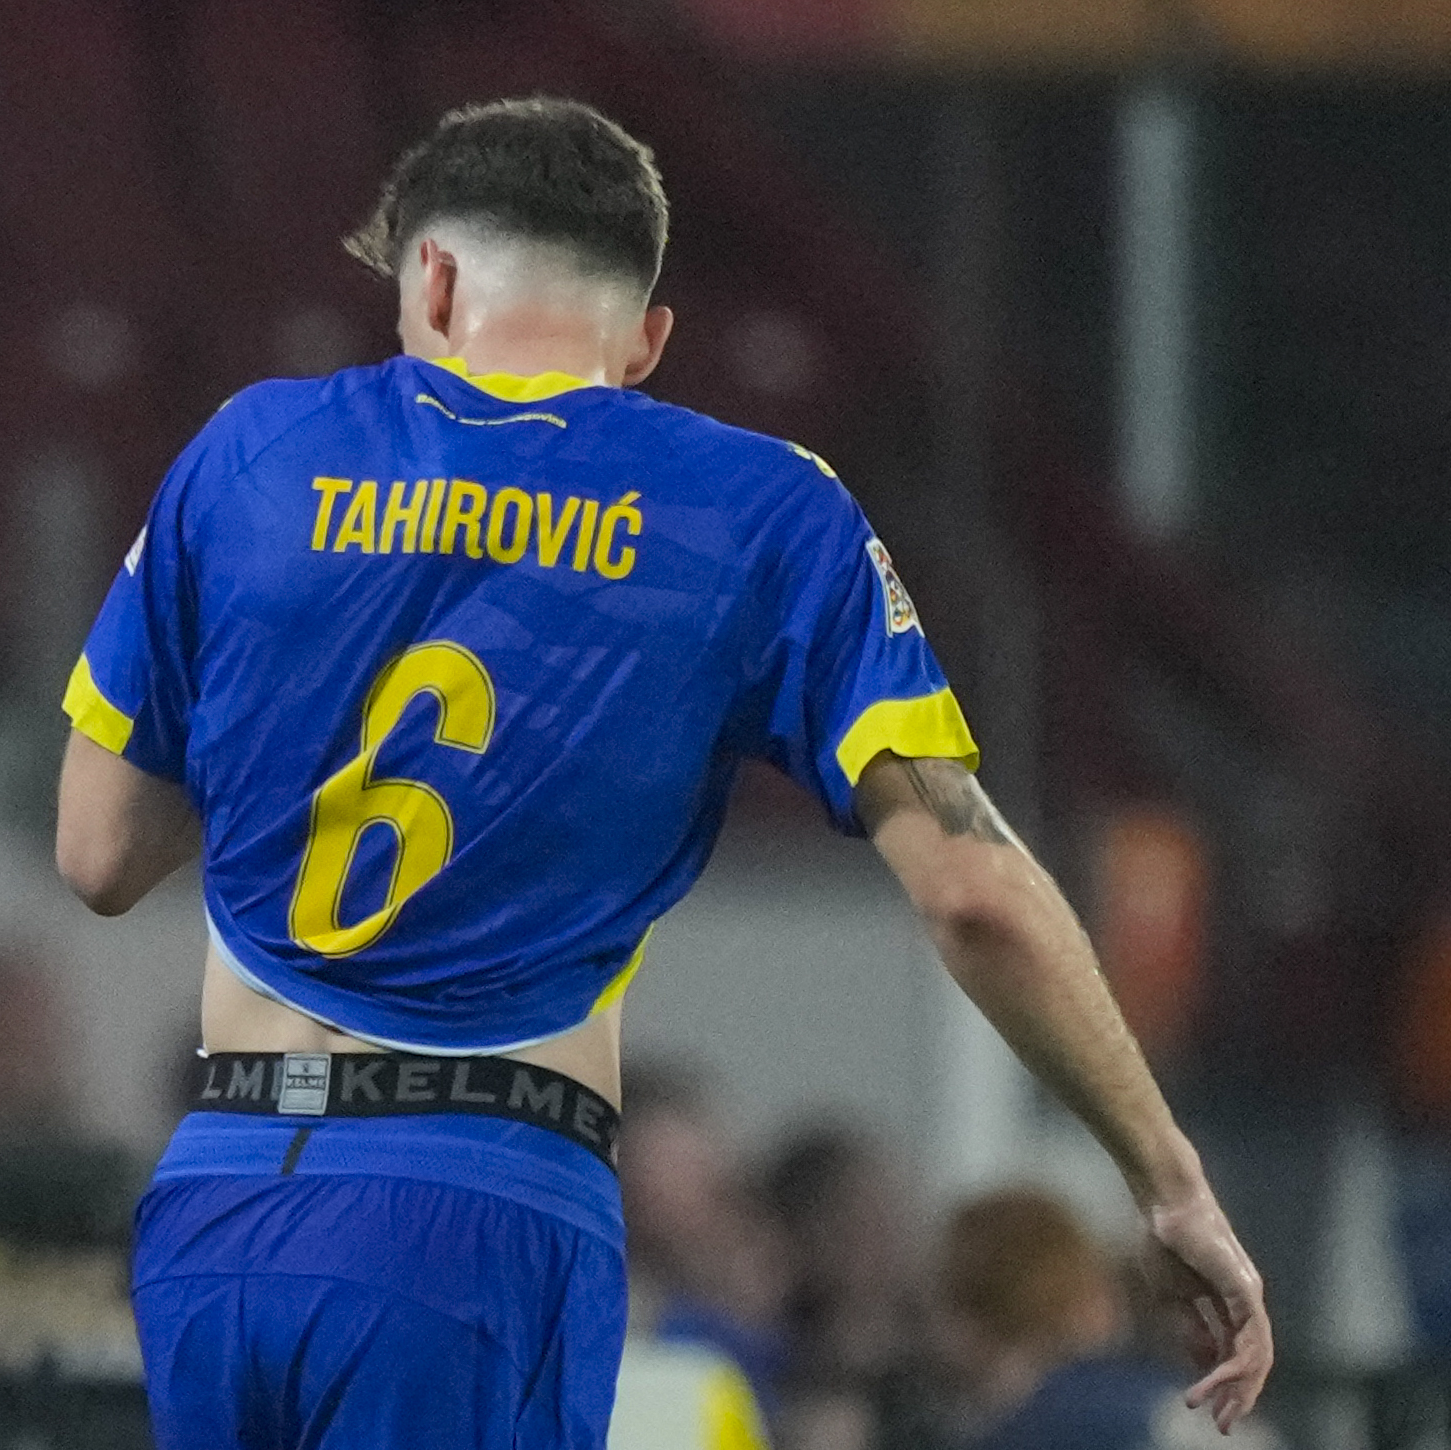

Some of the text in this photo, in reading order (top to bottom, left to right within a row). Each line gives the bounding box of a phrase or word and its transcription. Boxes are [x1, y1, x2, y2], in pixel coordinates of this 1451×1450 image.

[310, 475, 644, 580] TAHIROVIĆ
[287, 639, 497, 959] 6
[339, 1058, 608, 1145] KELME
